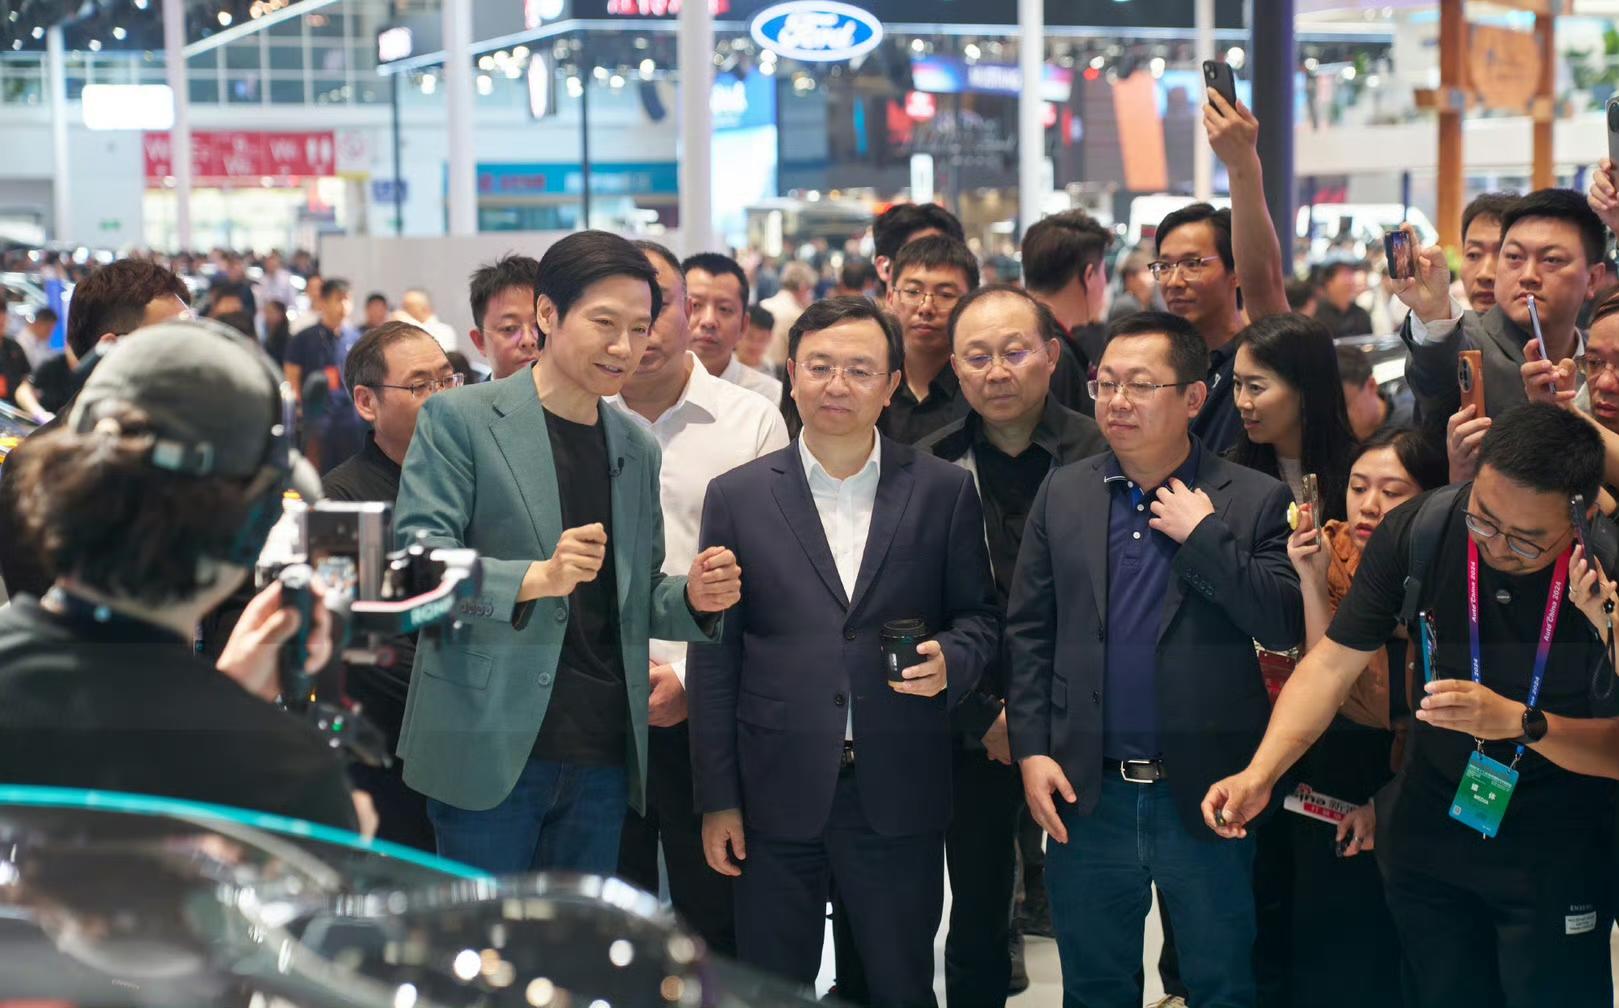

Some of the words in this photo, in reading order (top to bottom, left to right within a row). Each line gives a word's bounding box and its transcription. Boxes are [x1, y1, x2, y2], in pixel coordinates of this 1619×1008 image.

[778, 10, 857, 50] Ford
[1552, 581, 1562, 600] 2024
[1547, 601, 1558, 622] China
[1544, 622, 1553, 641] Auto
[1532, 676, 1540, 696] 2024
